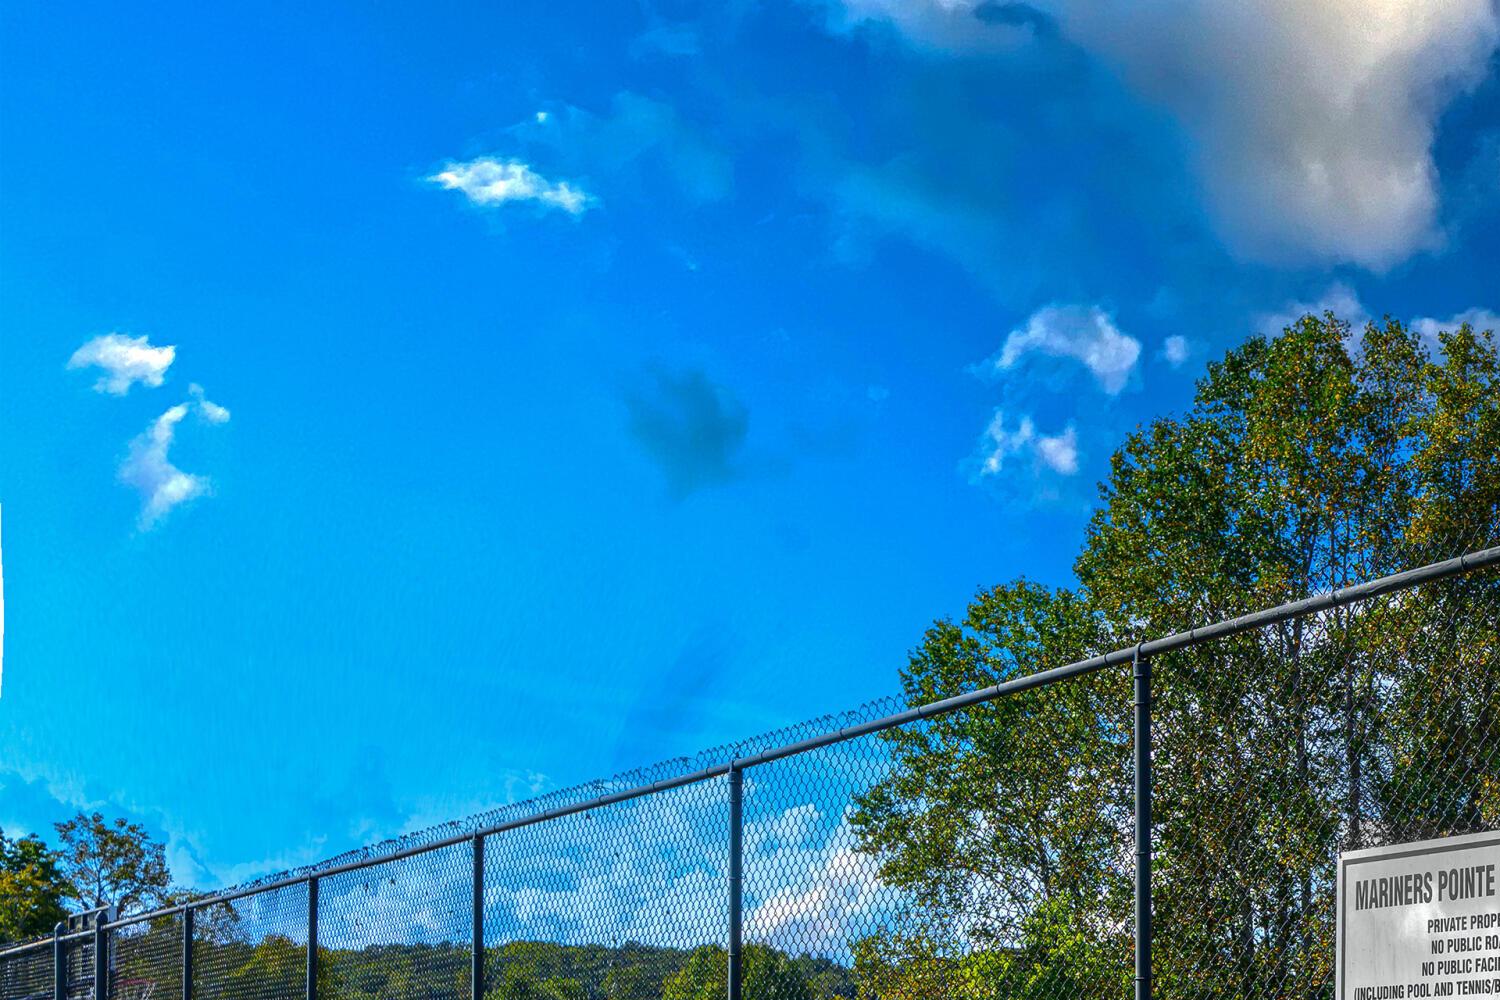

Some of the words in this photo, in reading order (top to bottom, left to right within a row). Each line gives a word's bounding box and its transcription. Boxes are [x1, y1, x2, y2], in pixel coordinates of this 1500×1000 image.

[1355, 871, 1433, 911] MARINERS
[1438, 863, 1496, 902] POINTE
[1427, 915, 1468, 934] PRIVATE
[1431, 939, 1445, 955] NO
[1447, 935, 1483, 954] PUBLIC
[1421, 961, 1435, 977] NO
[1437, 958, 1473, 976] PUBLIC
[1407, 982, 1432, 999] POOL
[1433, 981, 1454, 997] AND
